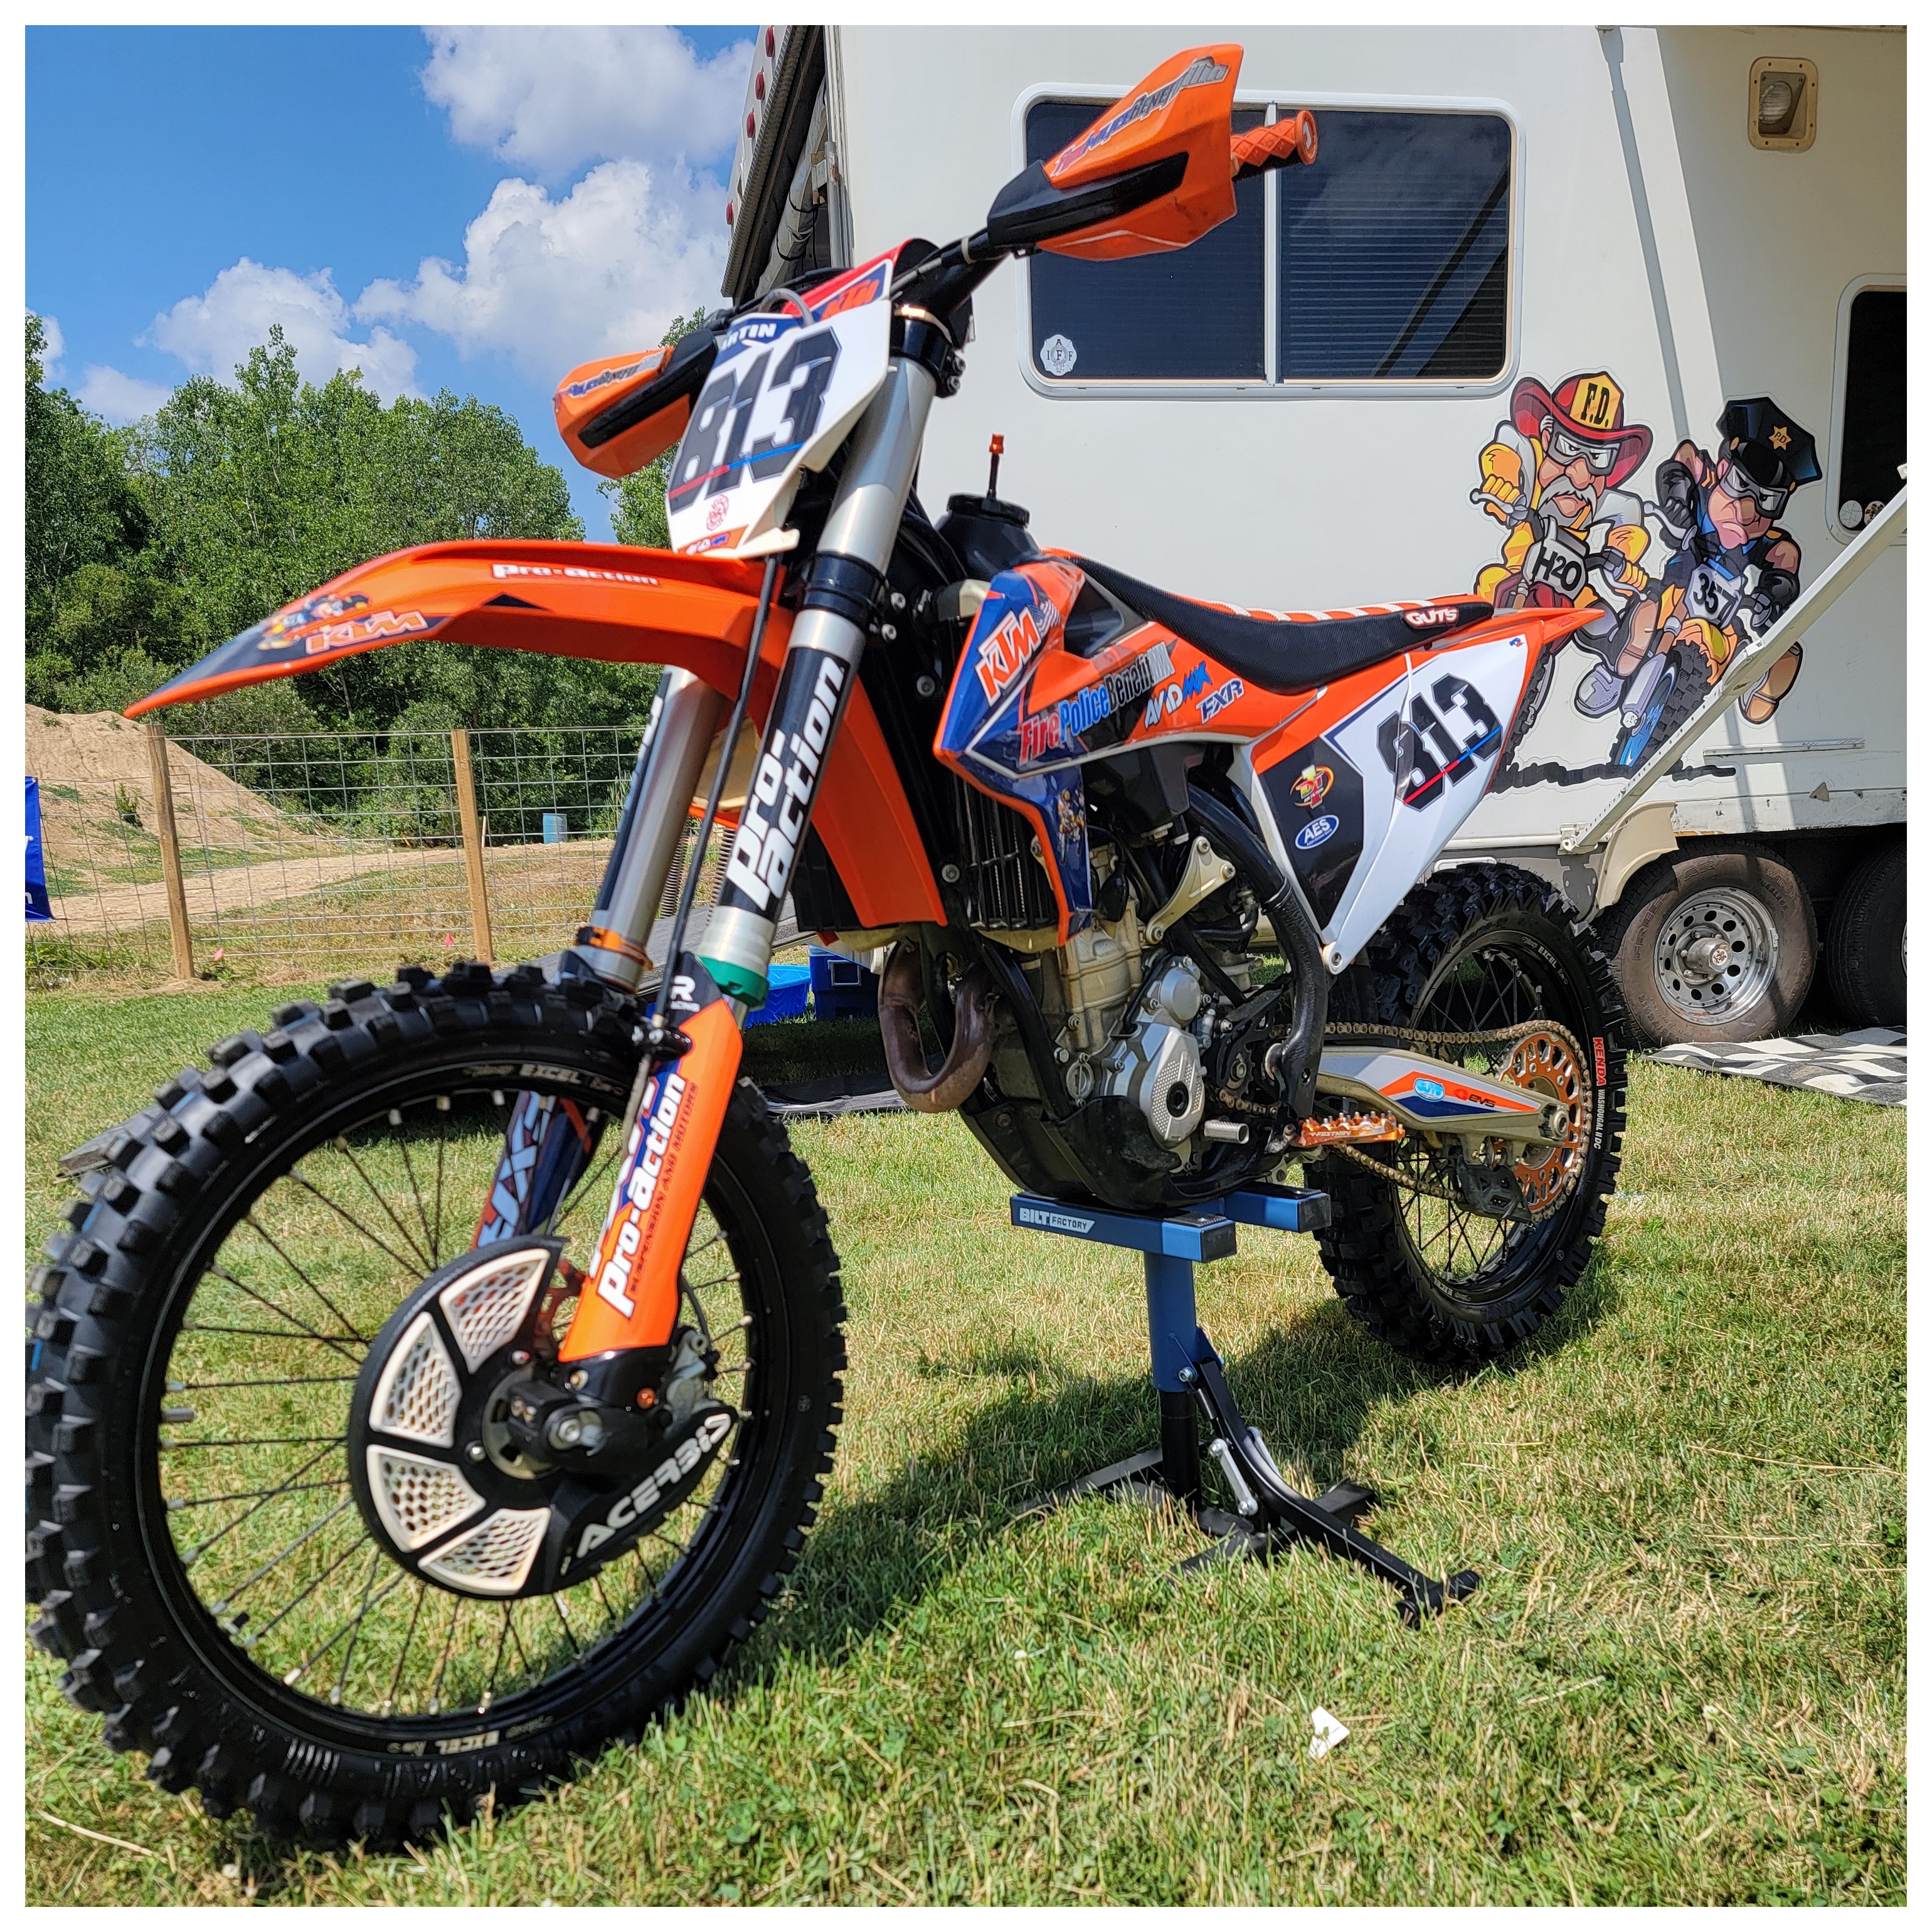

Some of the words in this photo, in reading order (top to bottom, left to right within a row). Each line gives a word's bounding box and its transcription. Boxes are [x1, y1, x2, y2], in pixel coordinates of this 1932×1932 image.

[669, 326, 842, 516] 813
[1580, 382, 1609, 428] F.D.
[1774, 430, 1787, 445] P.D.
[1529, 544, 1582, 591] H2O
[1693, 572, 1719, 613] 35
[1406, 607, 1457, 625] GUTS
[975, 606, 1041, 707] KTM
[1196, 677, 1245, 724] FXR
[1376, 672, 1503, 812] 813
[1303, 819, 1331, 844] AES
[1537, 945, 1558, 969] EXCEL
[519, 1063, 582, 1084] EXCEL
[1592, 1037, 1607, 1086] KENDA
[1595, 1089, 1606, 1131] WASHOUGAL
[1593, 1138, 1603, 1150] DC
[1019, 1207, 1049, 1226] BILT
[1052, 1216, 1087, 1230] FACTORY
[435, 1729, 500, 1755] EXCEL
